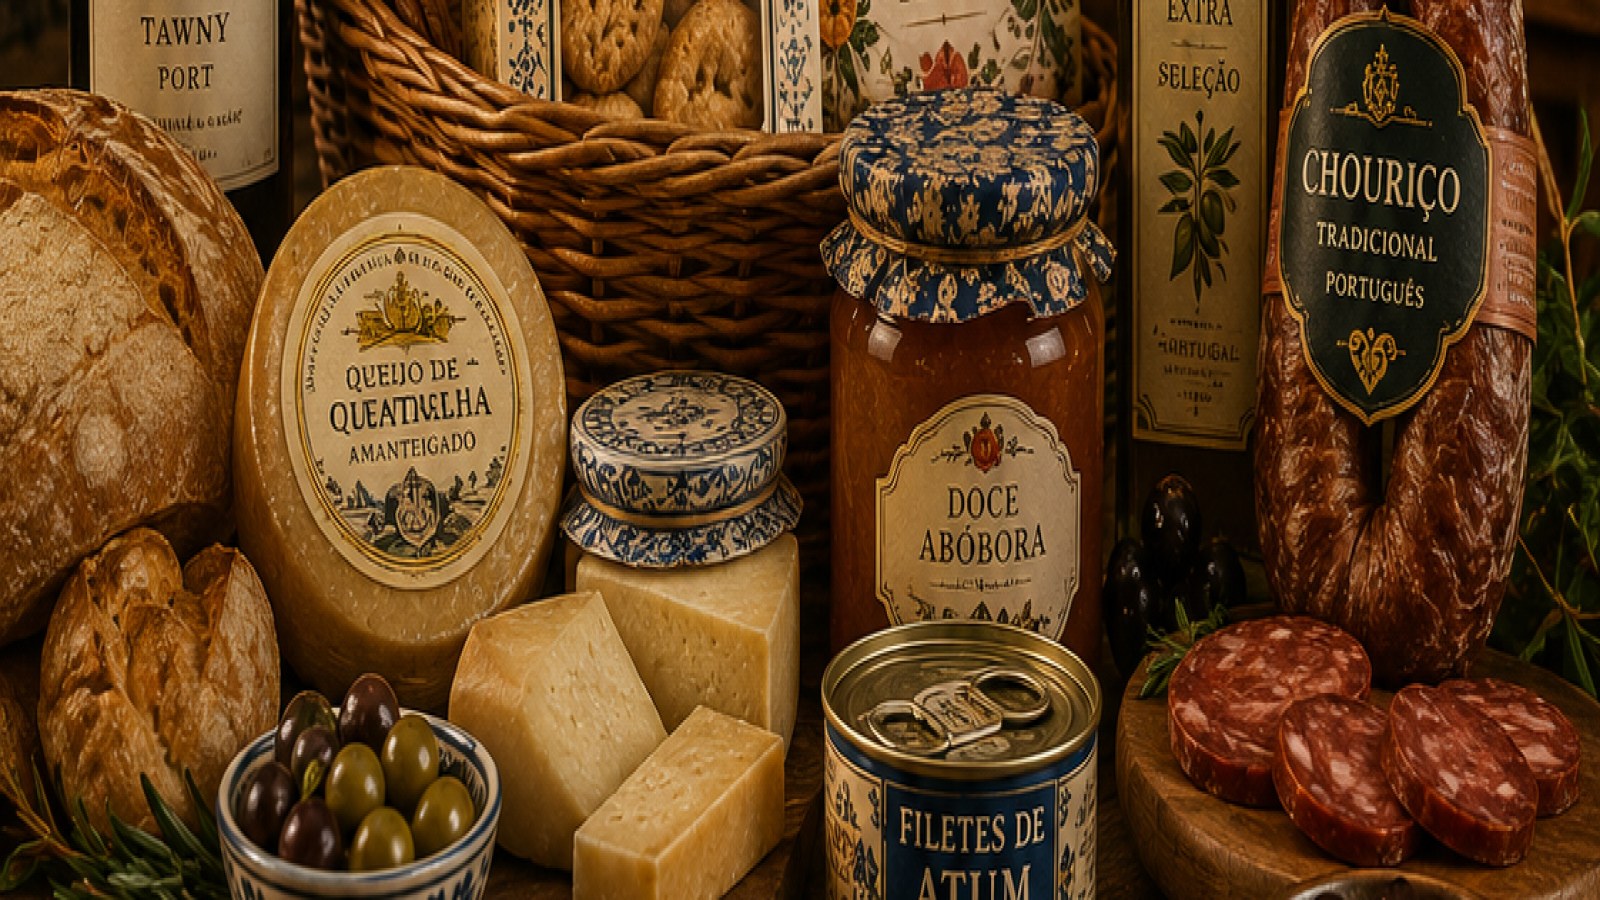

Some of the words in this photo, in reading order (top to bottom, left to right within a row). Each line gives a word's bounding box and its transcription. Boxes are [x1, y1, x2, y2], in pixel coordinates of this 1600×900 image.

[141, 12, 230, 46] TAWNY
[1167, 0, 1233, 25] EXTRA
[157, 64, 214, 90] PORT
[1158, 59, 1240, 100] SELEÇÃO
[1302, 147, 1461, 223] CHOURIÇO
[1316, 221, 1438, 263] TRADICIONAL
[1325, 270, 1425, 309] PORTUGUÊS
[346, 361, 423, 393] QUEIJO
[429, 357, 460, 381] DE
[349, 430, 476, 465] AMANTEIGADO
[947, 484, 1019, 520] DOCE
[919, 522, 1046, 566] ABÓBORA
[899, 805, 1006, 854] FILETES
[1014, 805, 1046, 849] DE
[917, 863, 1032, 900] ATUM
